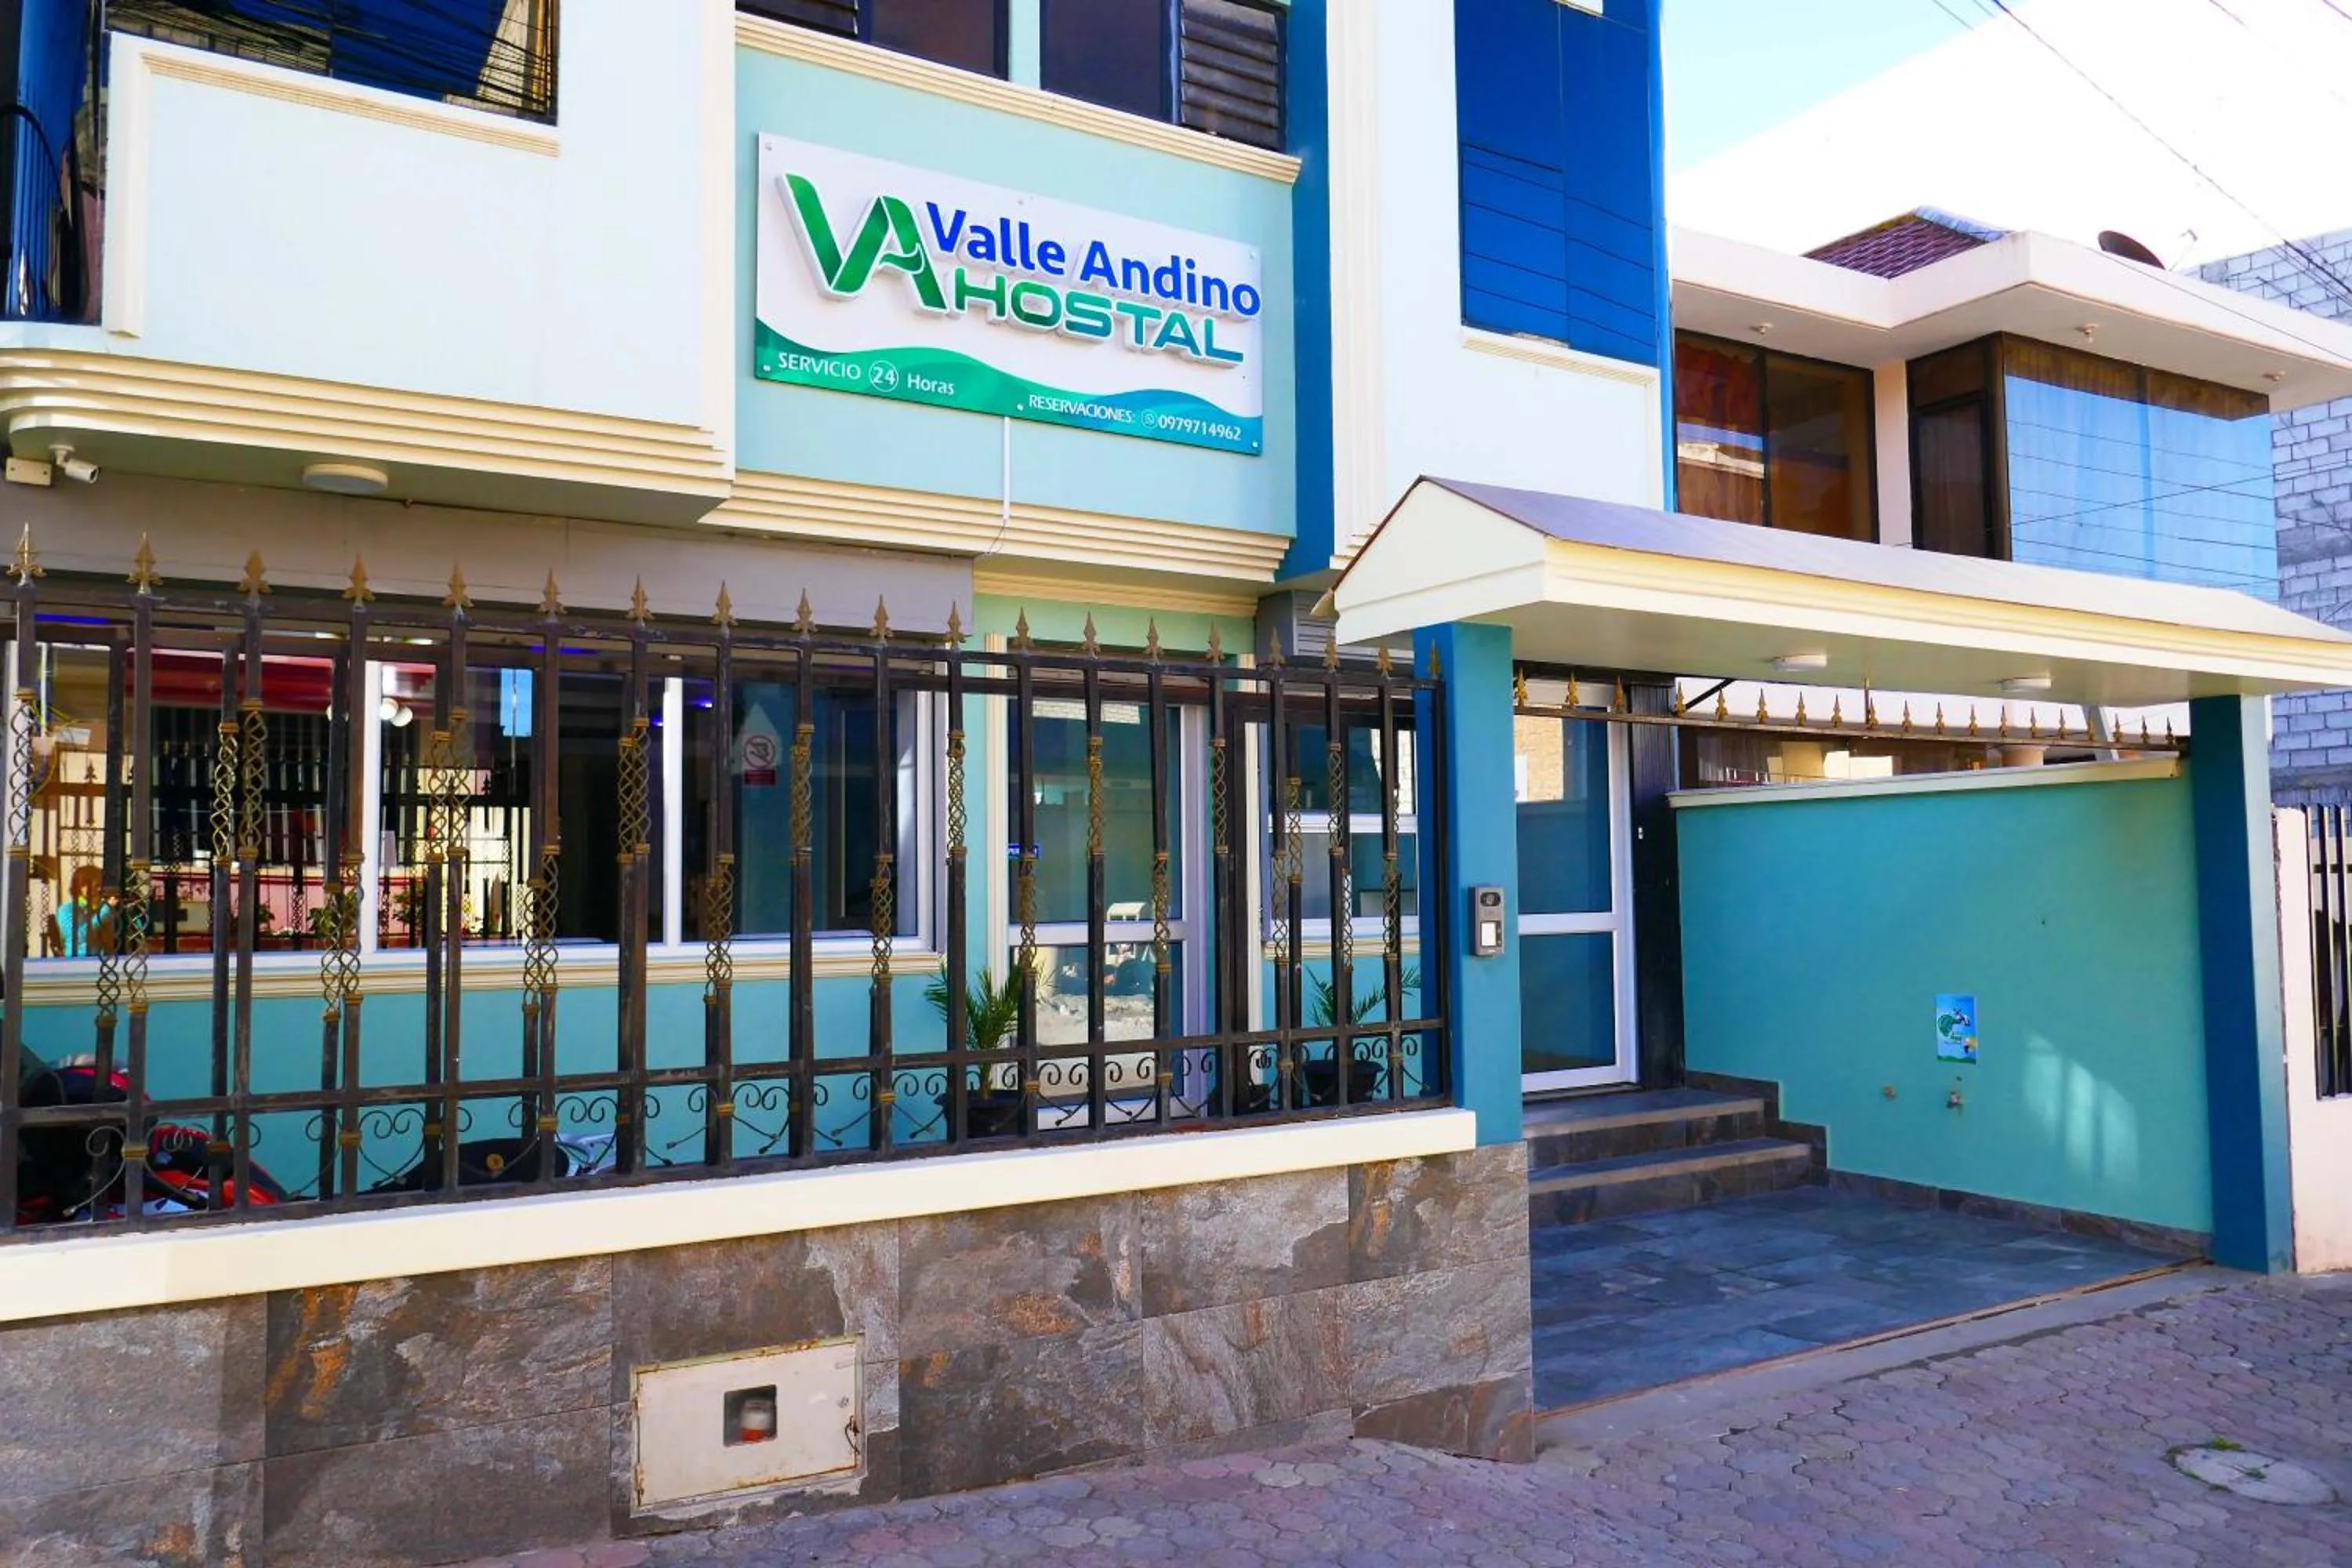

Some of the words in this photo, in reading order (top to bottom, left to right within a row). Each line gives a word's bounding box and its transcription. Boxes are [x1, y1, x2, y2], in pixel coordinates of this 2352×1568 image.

[926, 201, 1065, 276] Valle
[1079, 239, 1261, 317] Andino
[953, 267, 1245, 364] HOSTAL
[778, 352, 862, 381] SERVICIO
[871, 366, 896, 386] 24
[907, 373, 955, 395] Horas
[1159, 414, 1242, 441] 0979714962
